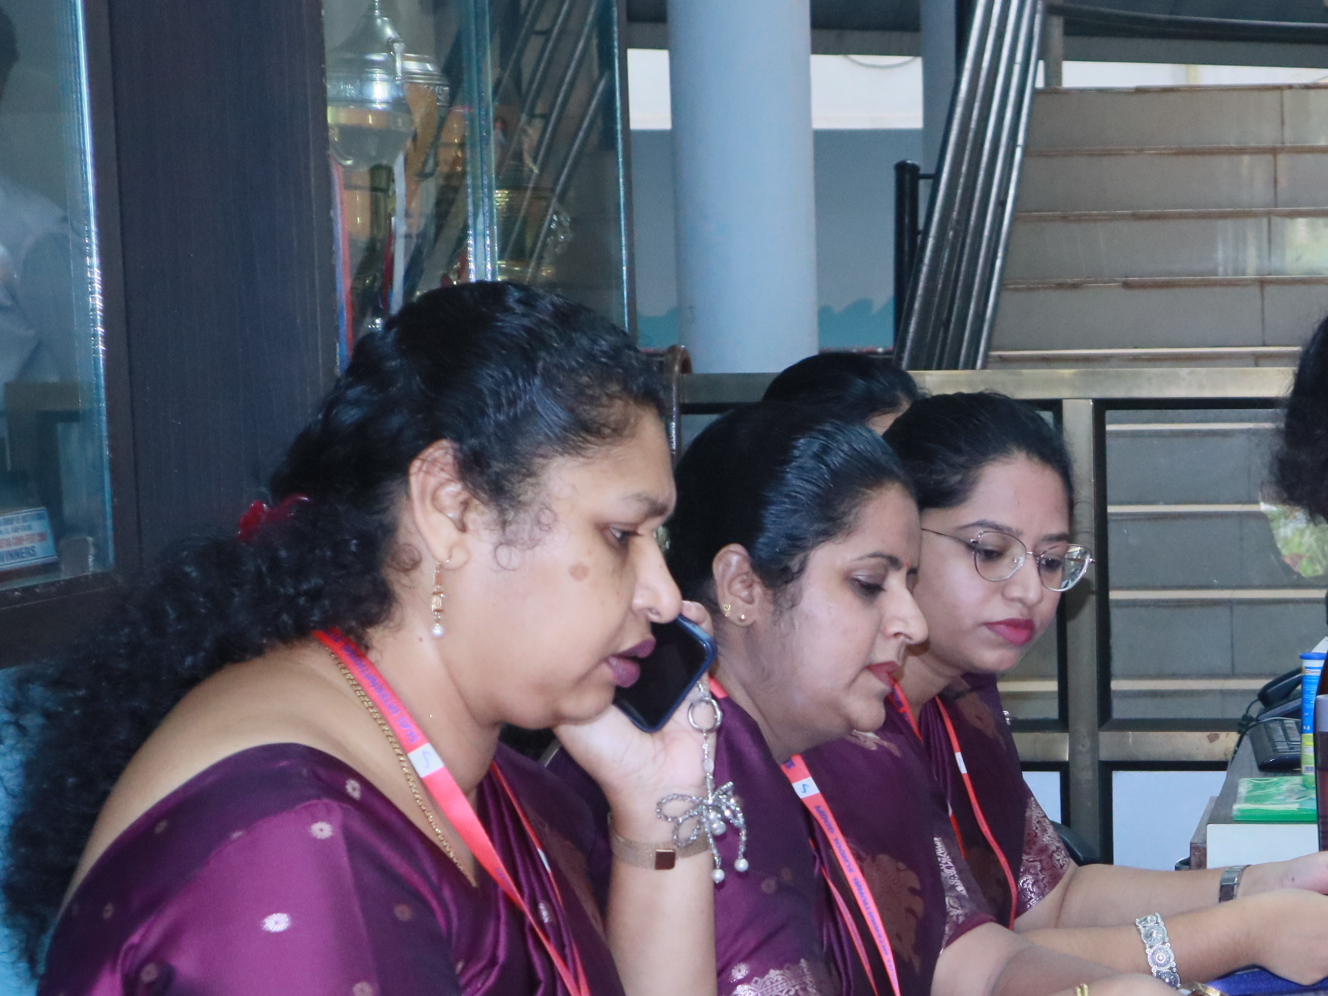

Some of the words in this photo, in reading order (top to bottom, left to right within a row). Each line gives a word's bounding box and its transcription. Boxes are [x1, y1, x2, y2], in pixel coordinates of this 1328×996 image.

[814, 805, 836, 834] UDUPI
[833, 838, 855, 873] SCHOOL
[852, 876, 889, 956] INTERNATIONAL
